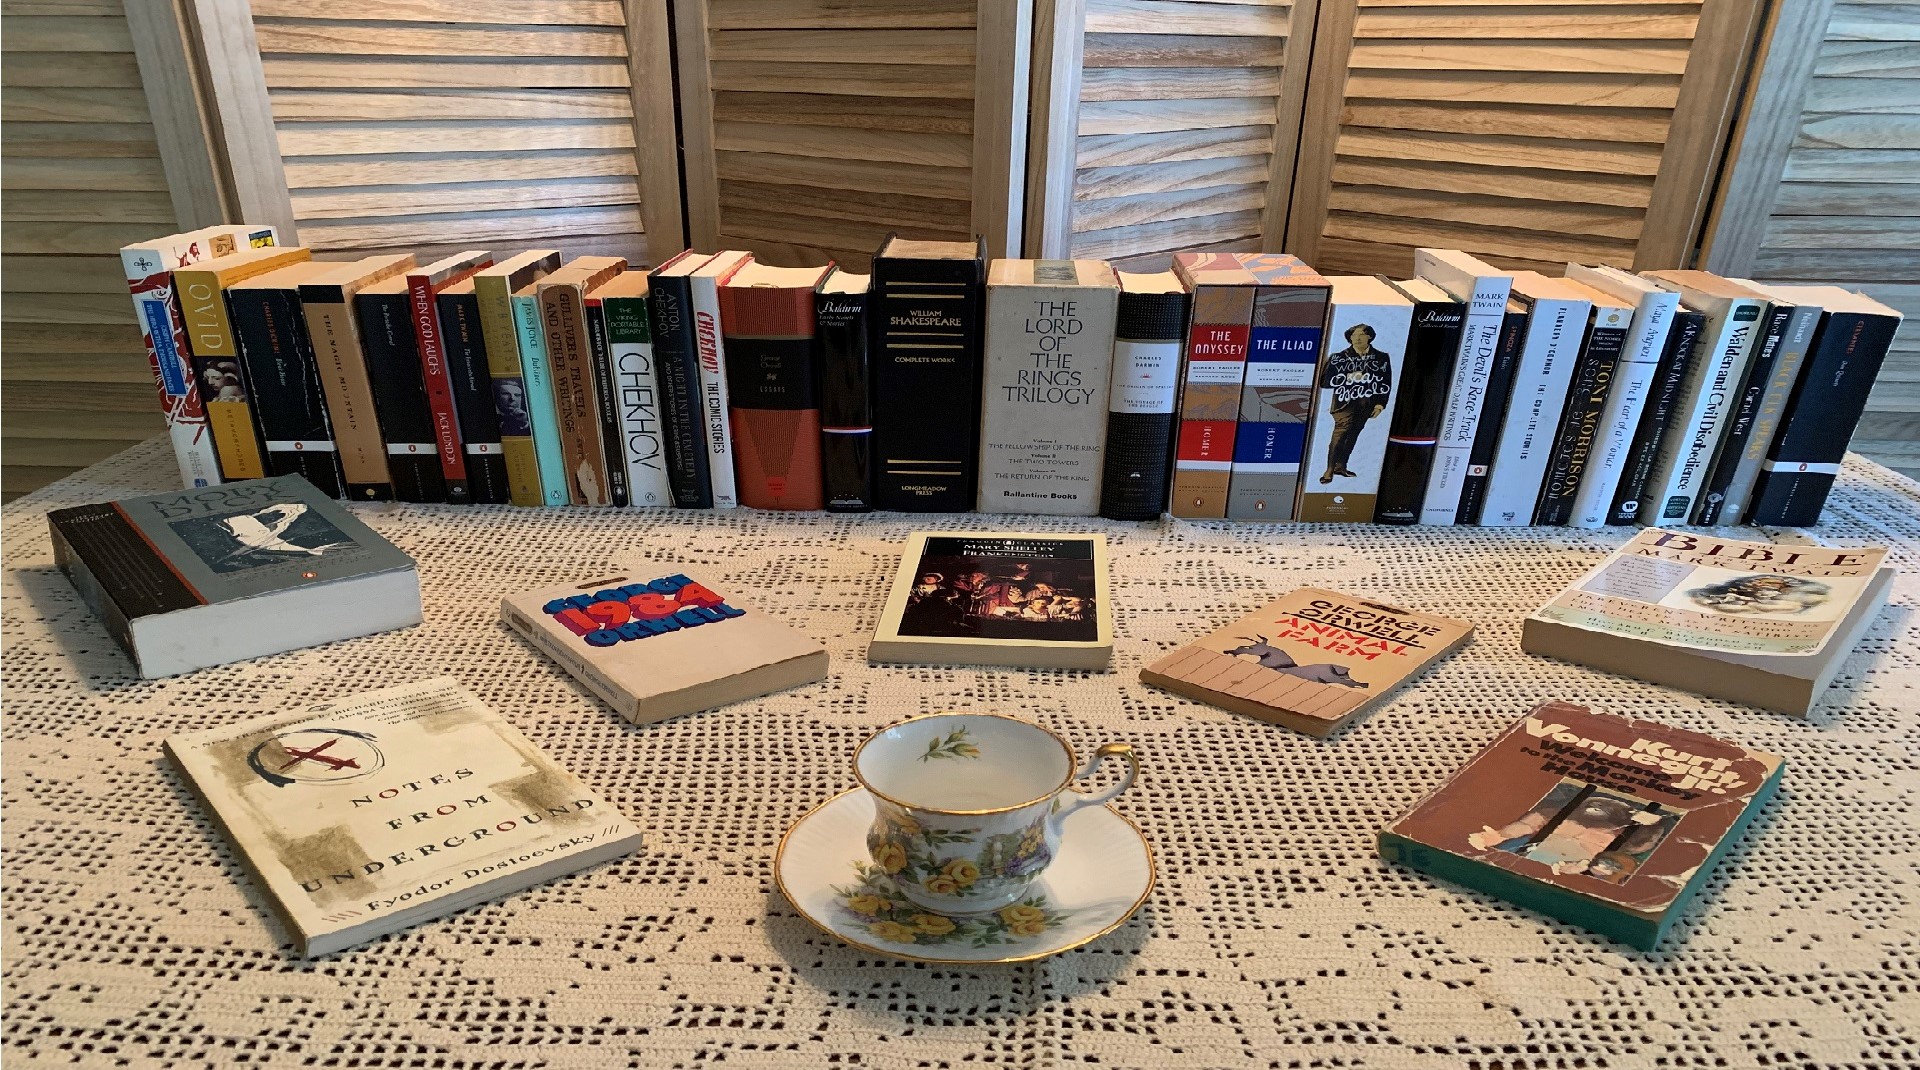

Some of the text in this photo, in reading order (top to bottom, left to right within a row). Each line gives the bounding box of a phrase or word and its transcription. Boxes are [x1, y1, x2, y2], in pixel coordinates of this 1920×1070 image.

[188, 284, 222, 349] OVID
[522, 302, 534, 326] JAMES
[655, 287, 670, 338] CHEKHOV
[666, 294, 680, 331] ANTON
[817, 299, 862, 314] Baldwin
[890, 316, 962, 326] SHAKESPEARE
[1034, 301, 1078, 316] THE
[1418, 308, 1462, 322] Baldwin
[1650, 302, 1668, 324] Maya
[323, 314, 334, 336] THE
[414, 286, 440, 376] WHEN GOD LAUGHS
[526, 327, 538, 348] JOYCE
[1025, 318, 1083, 335] LORD
[1210, 331, 1232, 341] THE
[1465, 324, 1476, 344] MARK
[1552, 308, 1568, 340] FLANNERY
[1762, 314, 1788, 358] Race Matters
[1793, 312, 1812, 343] Neihardt
[697, 312, 718, 374] CHEKHOV
[1038, 336, 1066, 352] OF
[1195, 344, 1244, 354] ODYSSEY
[1256, 340, 1313, 350] THE ILIAD
[546, 302, 575, 433] AND OTHER WRITINGS
[1030, 352, 1072, 369] THE
[1336, 361, 1380, 372] WORKS
[1656, 321, 1698, 422] A KNOCK AT MIDNIGHT
[1774, 352, 1800, 388] BLACK
[570, 367, 586, 418] TRAVELS
[1017, 370, 1082, 386] RINGS
[1330, 372, 1384, 388] Oscar
[1335, 383, 1391, 402] Wilde
[1454, 372, 1466, 391] GREAT
[1458, 325, 1498, 442] The Devil's Race-Track
[1628, 380, 1642, 394] The
[674, 365, 686, 396] NIGHT
[680, 413, 691, 430] THE
[1002, 386, 1096, 404] TRILOGY
[1622, 396, 1636, 420] Heart
[1678, 326, 1750, 490] Walden and Civil Disobedience
[1734, 386, 1760, 435] Cornel West
[1764, 394, 1783, 414] ELK
[619, 352, 661, 470] CHEKHOV
[707, 382, 725, 454] THE COMIC STORIES
[1444, 412, 1457, 441] WRITINGS
[1614, 421, 1628, 430] of
[437, 412, 456, 464] JACK LONDON
[1200, 426, 1212, 456] HOMER
[1562, 360, 1614, 496] TONI MORRISON
[1748, 420, 1775, 460] SPEAKS
[1066, 444, 1079, 452] THE
[1264, 428, 1276, 460] HOMER
[150, 481, 285, 509] MOBY
[155, 493, 297, 519] DICK
[1004, 490, 1048, 499] Ballantine
[963, 550, 1054, 558] FRANKENSTEIN
[1641, 531, 1869, 567] BIBLE
[1641, 549, 1727, 567] MARK
[1749, 564, 1861, 576] TWAIN
[552, 582, 725, 637] 1984
[584, 602, 747, 647] ORWELL
[1310, 600, 1441, 637] GEORGE
[1274, 617, 1408, 656] ANIMAL
[1299, 608, 1420, 644] ORWELL
[1277, 629, 1382, 661] FARM
[335, 700, 385, 715] RICHARD
[1540, 740, 1673, 782] Welcome
[1629, 738, 1732, 771] Kurt
[352, 766, 475, 809] NOTES
[1520, 746, 1703, 801] to the Monkey
[1540, 762, 1638, 794] House
[1670, 774, 1728, 795] Jr.
[386, 794, 492, 832] FROM
[298, 798, 595, 894] UNDERGROUND
[366, 832, 598, 912] Fyodor Dostoevsky
